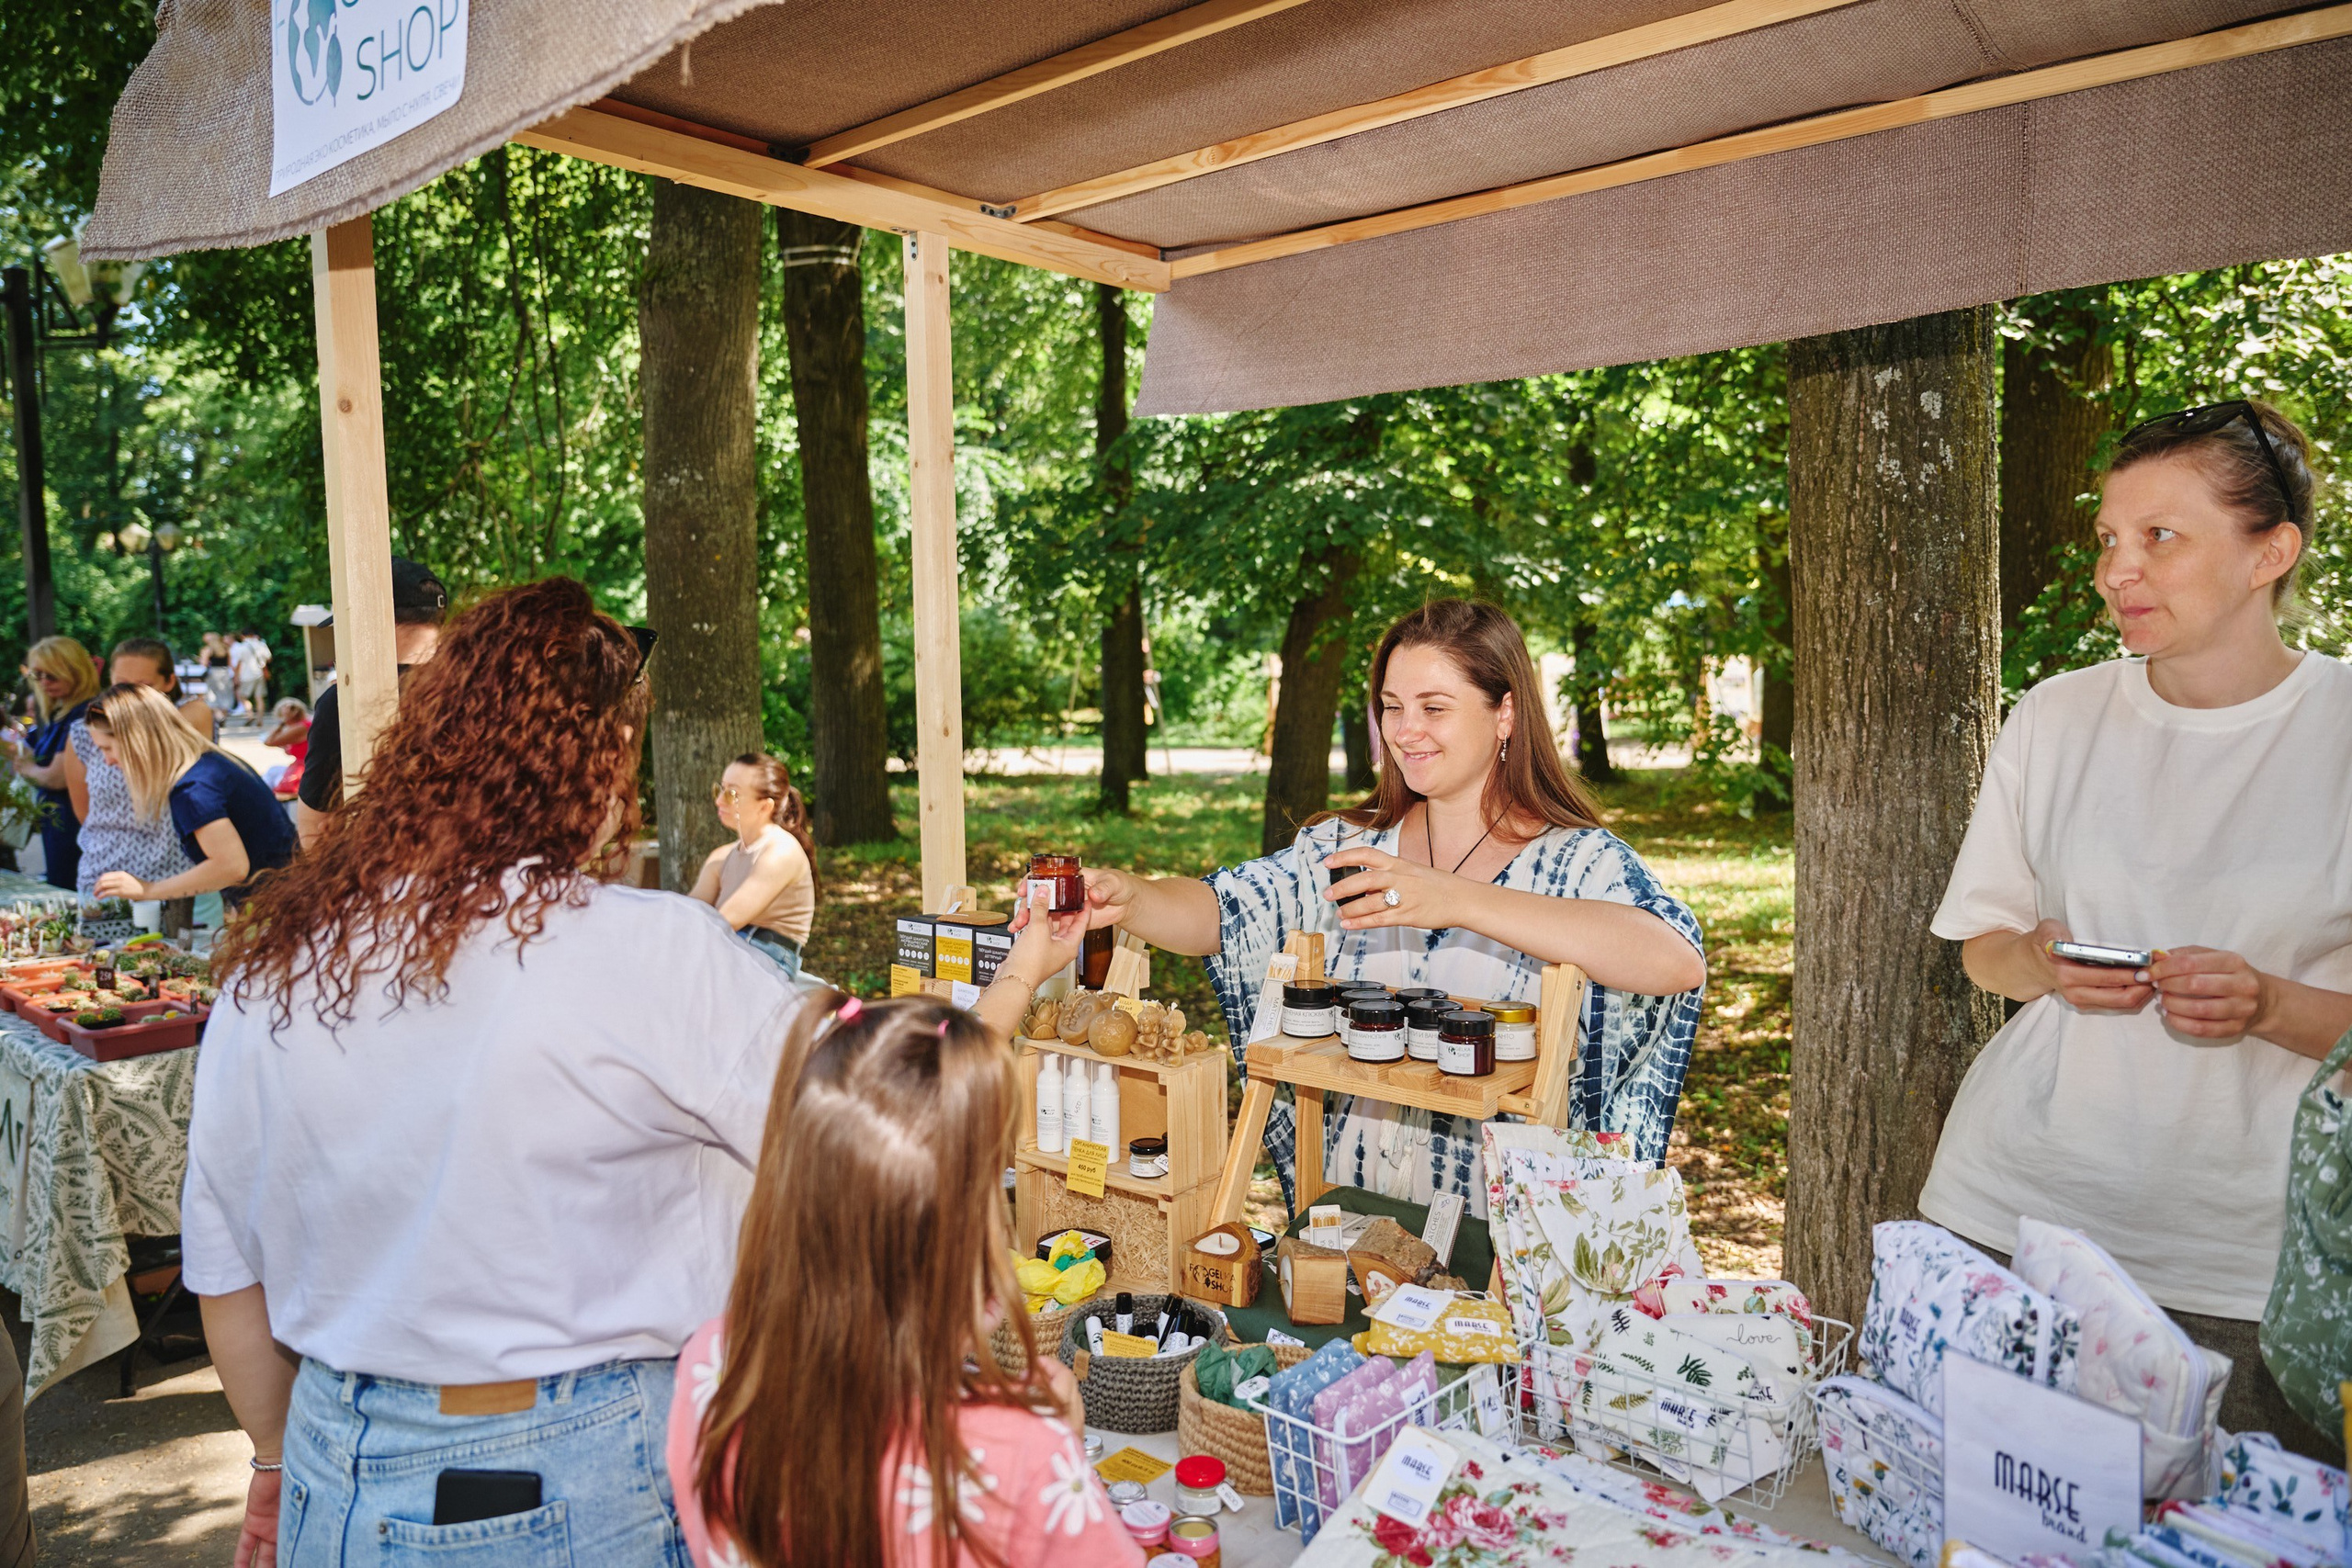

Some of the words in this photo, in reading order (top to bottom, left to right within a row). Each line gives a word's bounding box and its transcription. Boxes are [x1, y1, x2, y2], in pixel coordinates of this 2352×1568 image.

[356, 0, 459, 101] SHOP
[1266, 997, 1280, 1032] MATCHES
[1211, 1280, 1234, 1293] SHOP
[1726, 1324, 1781, 1344] love
[1995, 1450, 2080, 1524] MARSE
[2041, 1507, 2087, 1544] brand
